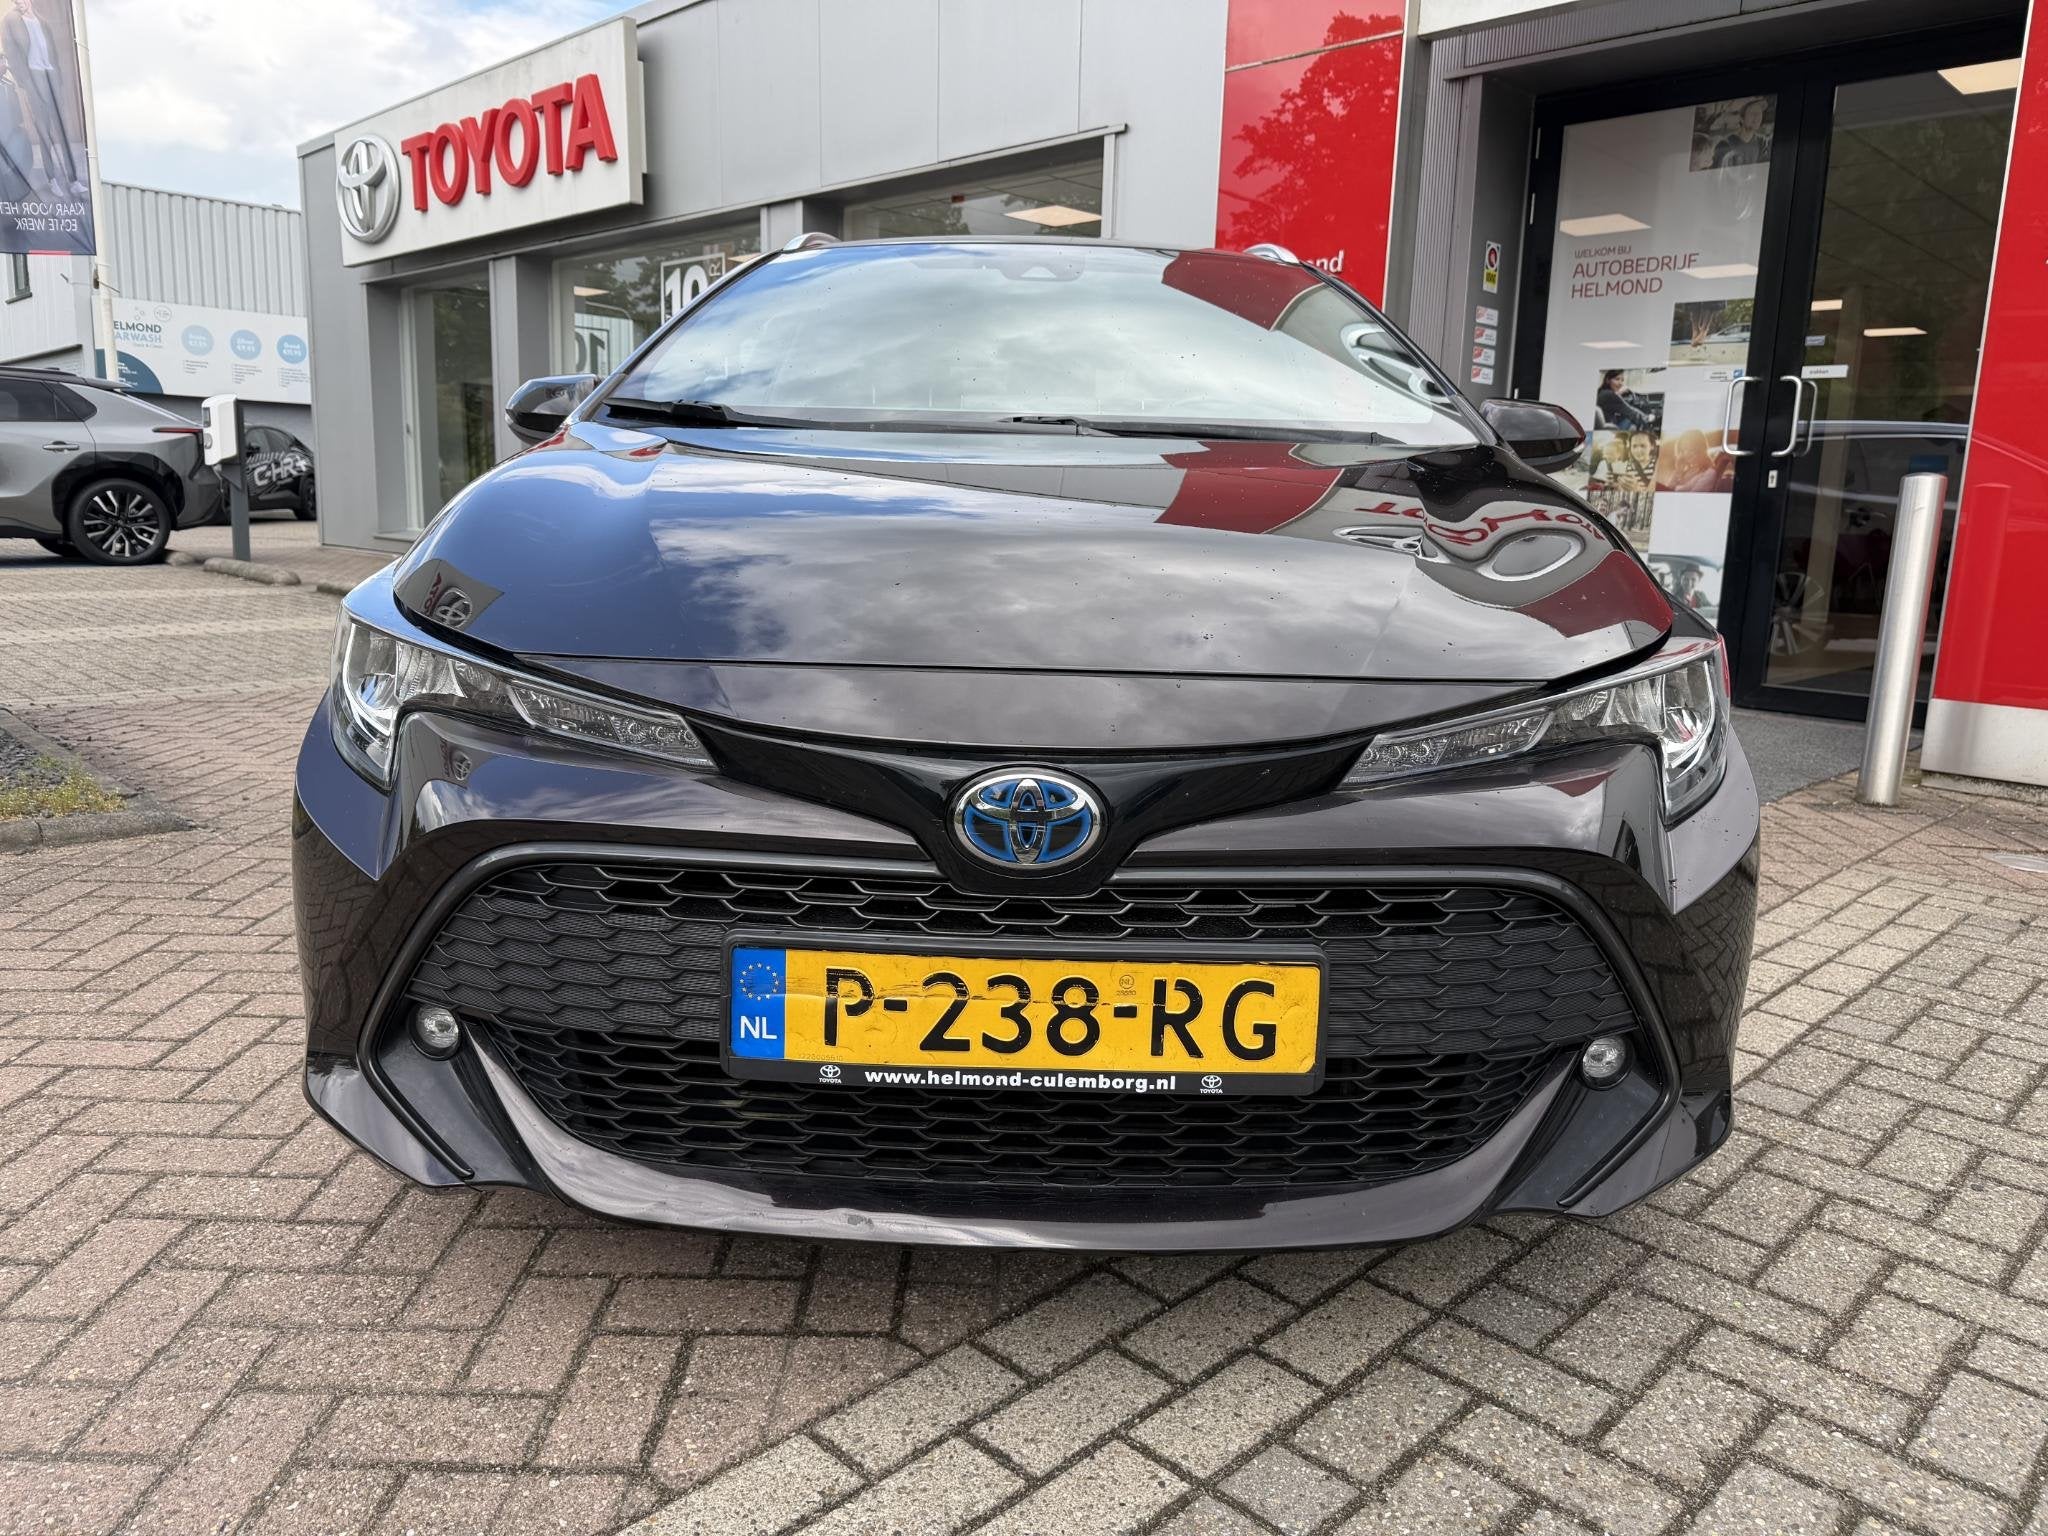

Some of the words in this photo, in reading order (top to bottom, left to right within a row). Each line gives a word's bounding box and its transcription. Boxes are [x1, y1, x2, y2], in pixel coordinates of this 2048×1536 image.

[402, 73, 618, 213] TOYOTA
[1574, 246, 1615, 259] WELKOM
[1617, 245, 1631, 256] BIJ
[1572, 253, 1699, 279] AUTOBEDRIJF
[1571, 277, 1663, 299] HELMOND
[112, 320, 162, 334] ELMOND
[112, 330, 162, 343] ARWASH
[823, 967, 1278, 1061] P-238-RG
[739, 1015, 778, 1040] NL
[864, 1068, 1176, 1093] www.helmond-culemborg.nl
